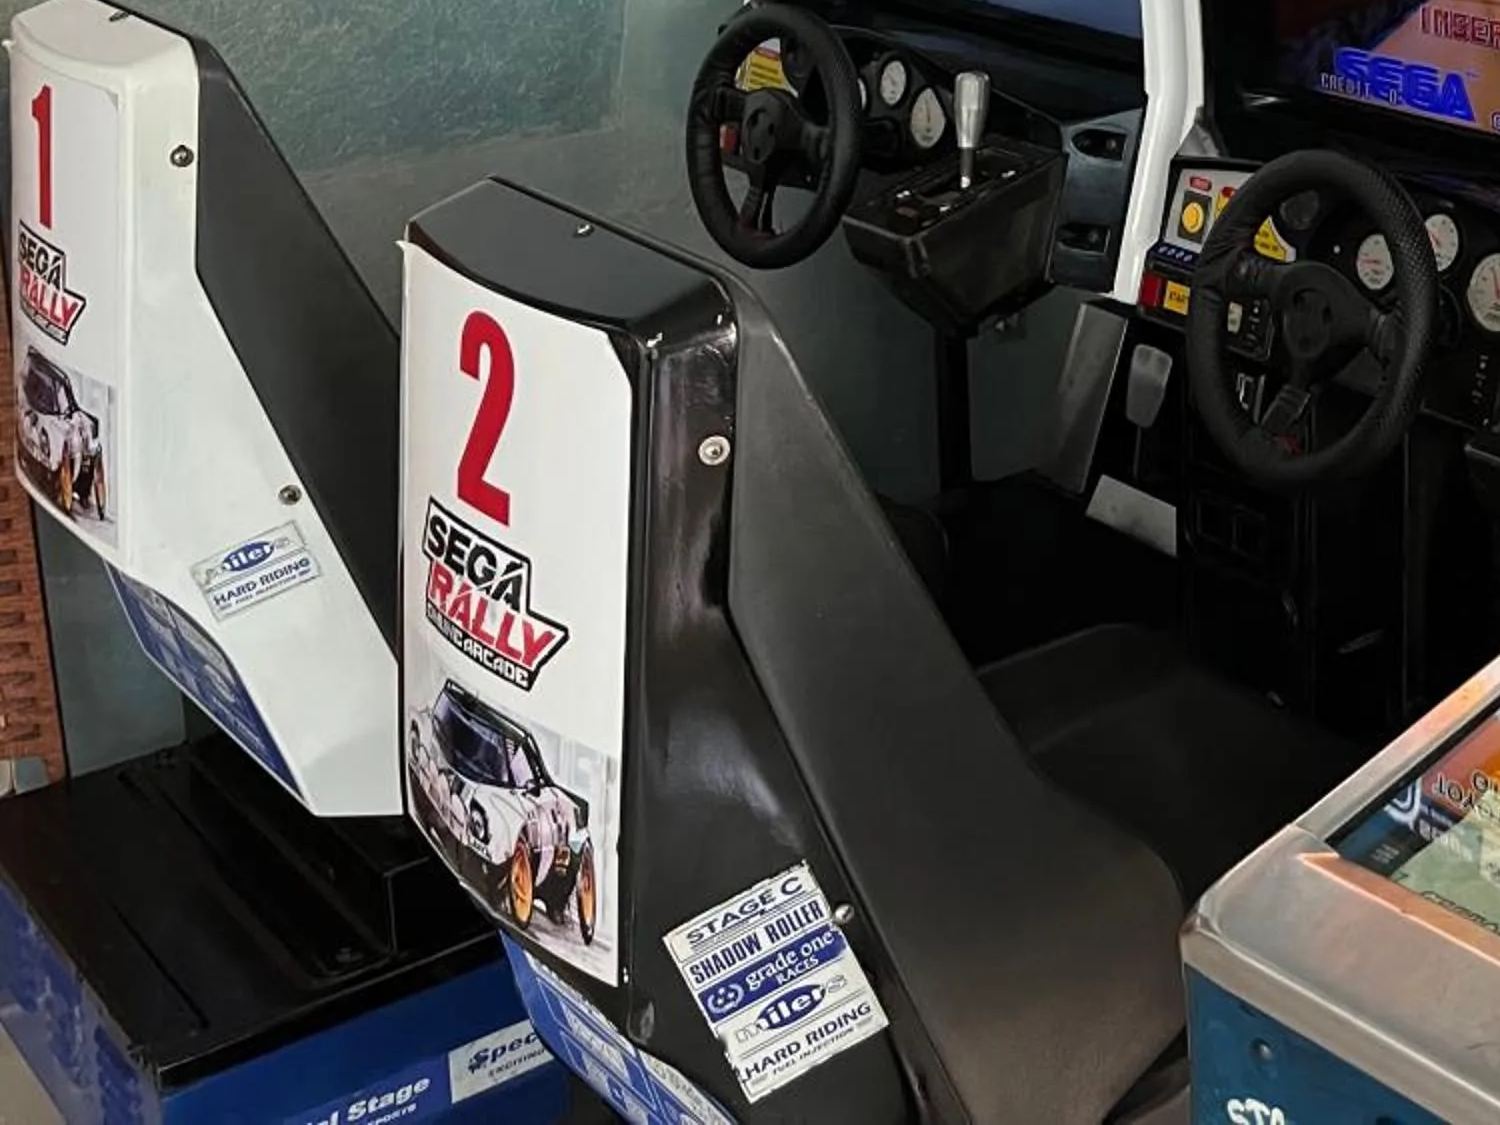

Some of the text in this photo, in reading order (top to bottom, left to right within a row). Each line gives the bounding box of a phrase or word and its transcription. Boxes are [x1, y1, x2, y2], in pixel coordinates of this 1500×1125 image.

[1335, 46, 1477, 122] SEGA
[31, 86, 53, 230] 1
[20, 231, 62, 291] SEGA
[20, 267, 79, 328] RALLY
[457, 309, 516, 528] 2
[212, 579, 258, 606] HARD
[258, 556, 311, 588] RIDING
[428, 514, 524, 613] SEGA
[430, 561, 557, 668] RALLY
[463, 635, 530, 687] ARCADE
[686, 876, 804, 945] STAGE C
[689, 899, 825, 985] SHADOW ROLLER
[745, 929, 835, 993] grade one
[775, 956, 820, 986] RACES
[467, 1030, 539, 1073] Spec
[744, 1001, 872, 1083] HARD RIDING
[347, 1076, 431, 1121] Stage
